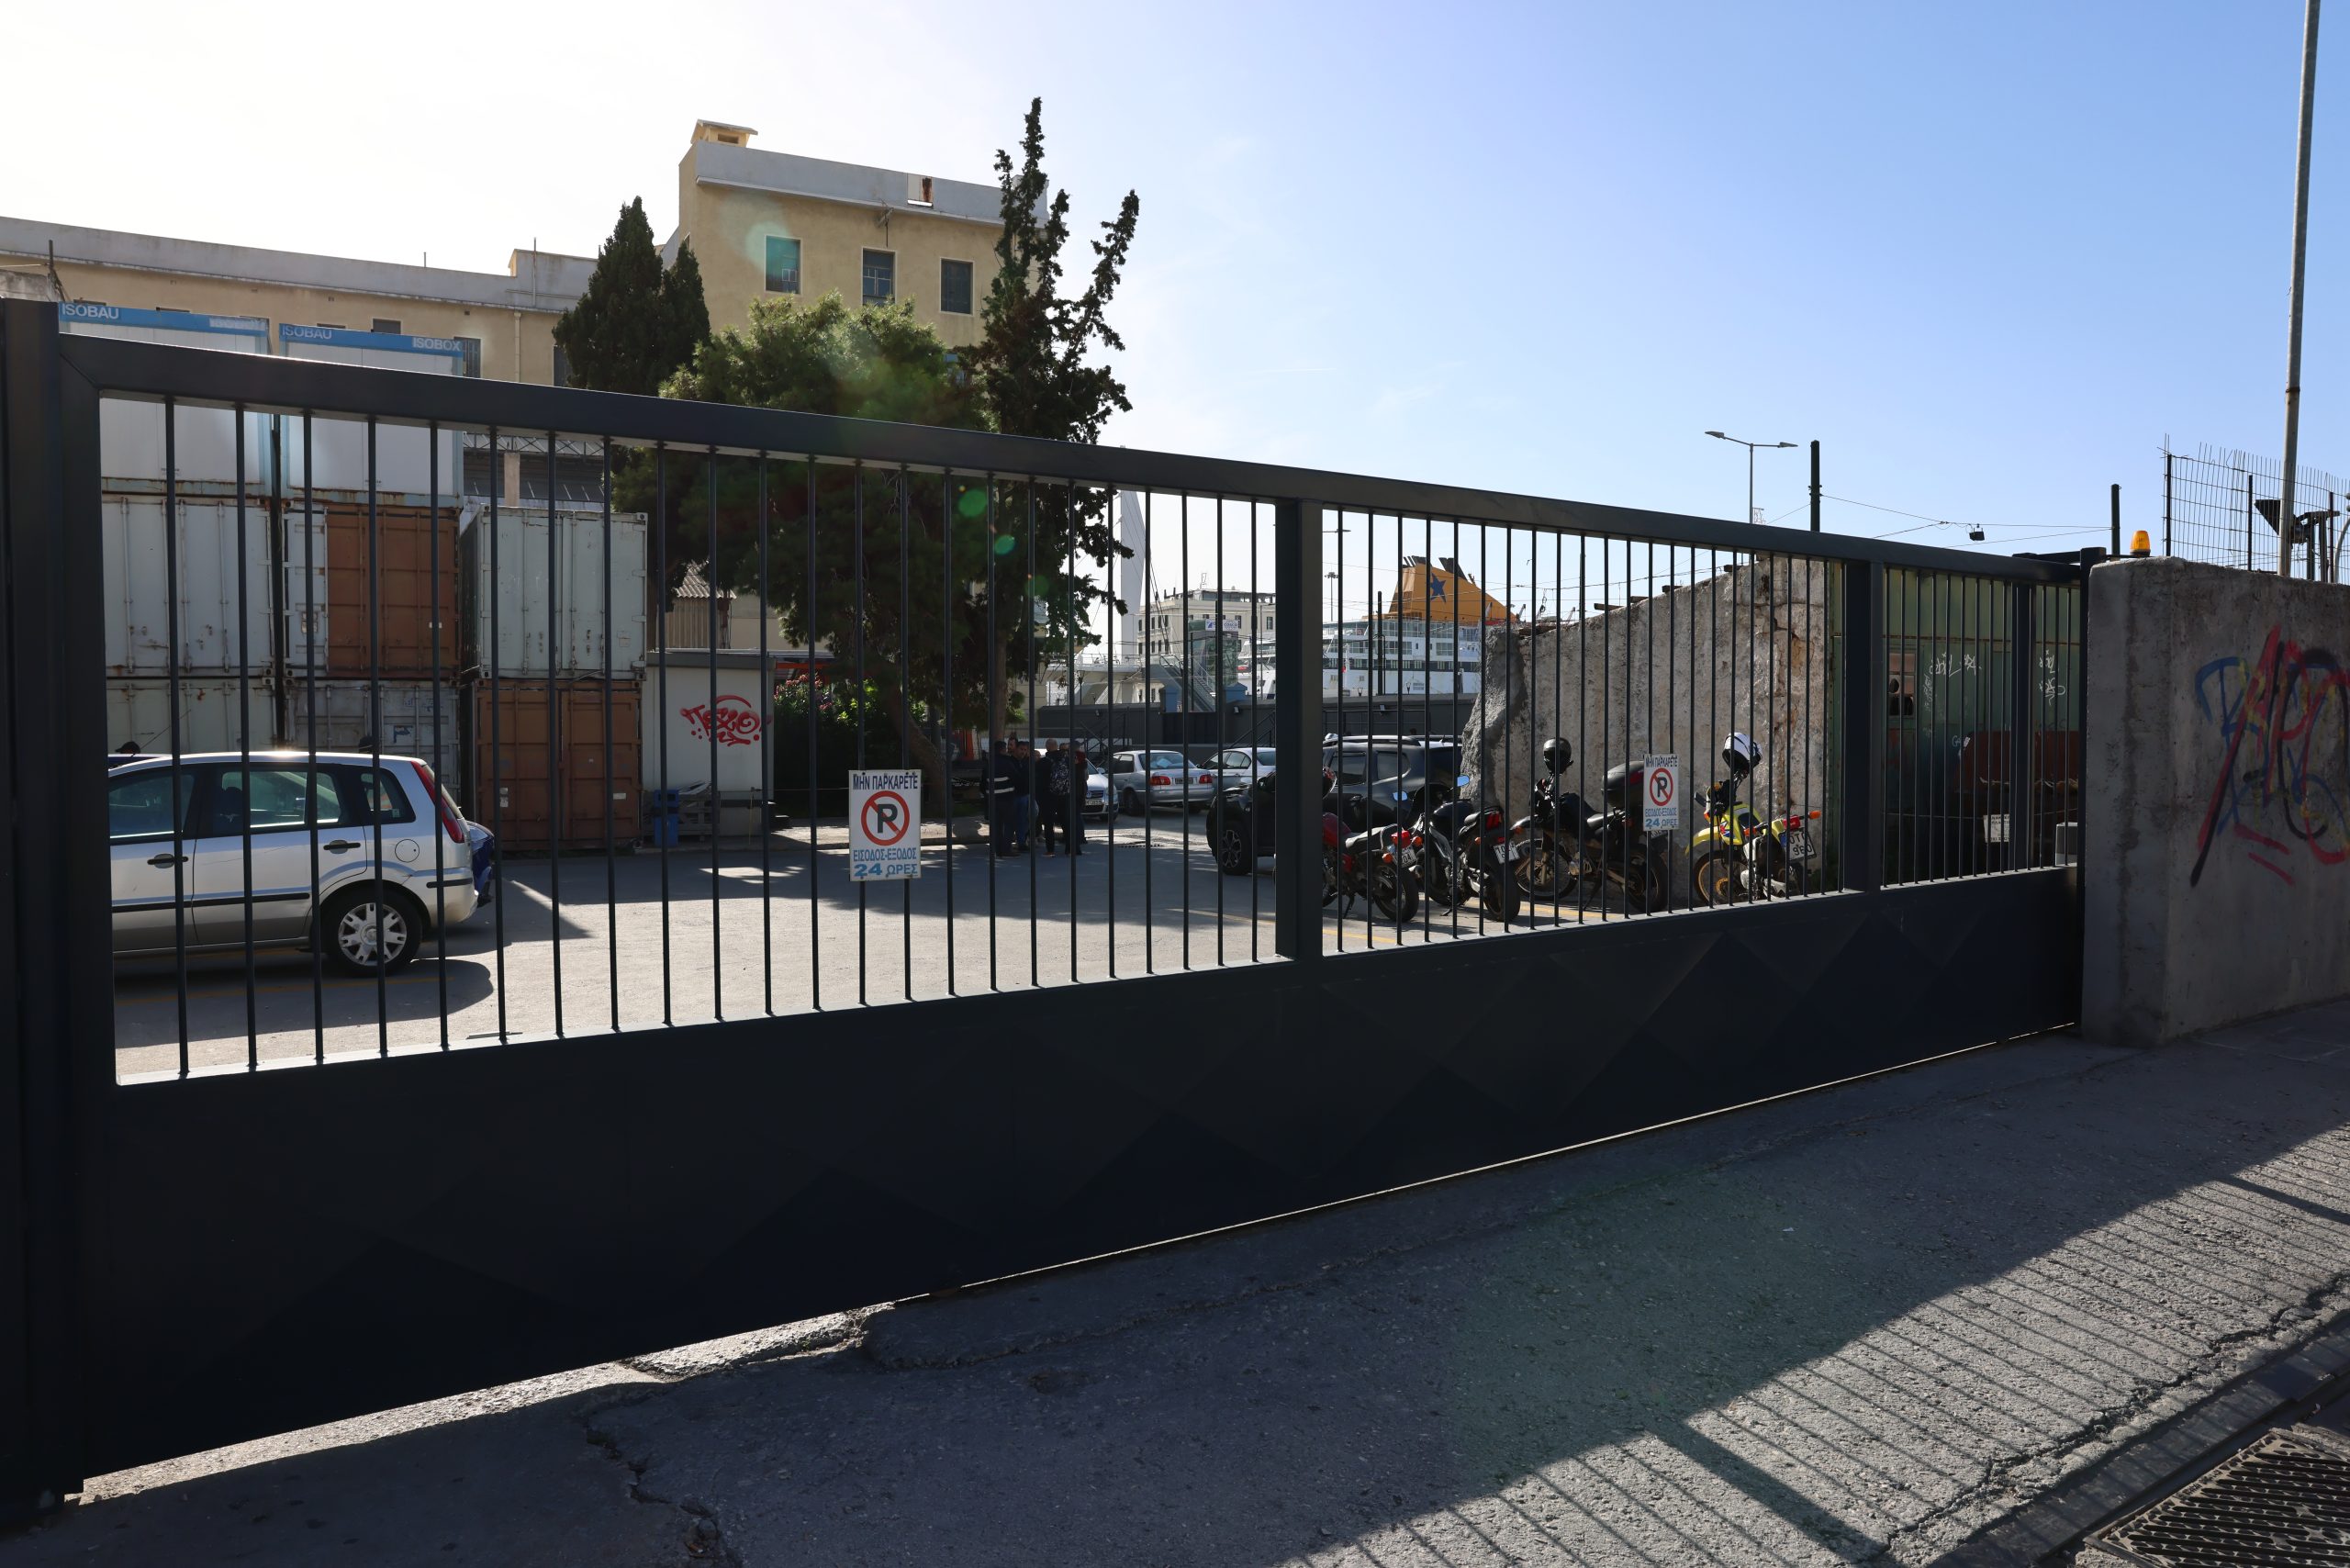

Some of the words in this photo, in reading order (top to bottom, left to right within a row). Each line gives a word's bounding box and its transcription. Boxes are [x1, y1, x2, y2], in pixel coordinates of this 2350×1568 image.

[62, 303, 119, 319] ISOBAU
[282, 324, 332, 340] ISOBAU
[413, 336, 461, 352] ISOBOX
[853, 773, 870, 790] ΜΗΝ
[872, 775, 918, 790] ΠΑΡΚΑΡΕΤΕ
[1645, 818, 1660, 827] 24
[853, 847, 917, 862] ΕΙΣΟΔΟΣ-ΕΞΟΔΟΣ
[854, 863, 882, 877] 24
[886, 864, 918, 876] ΩΡΕΣ
